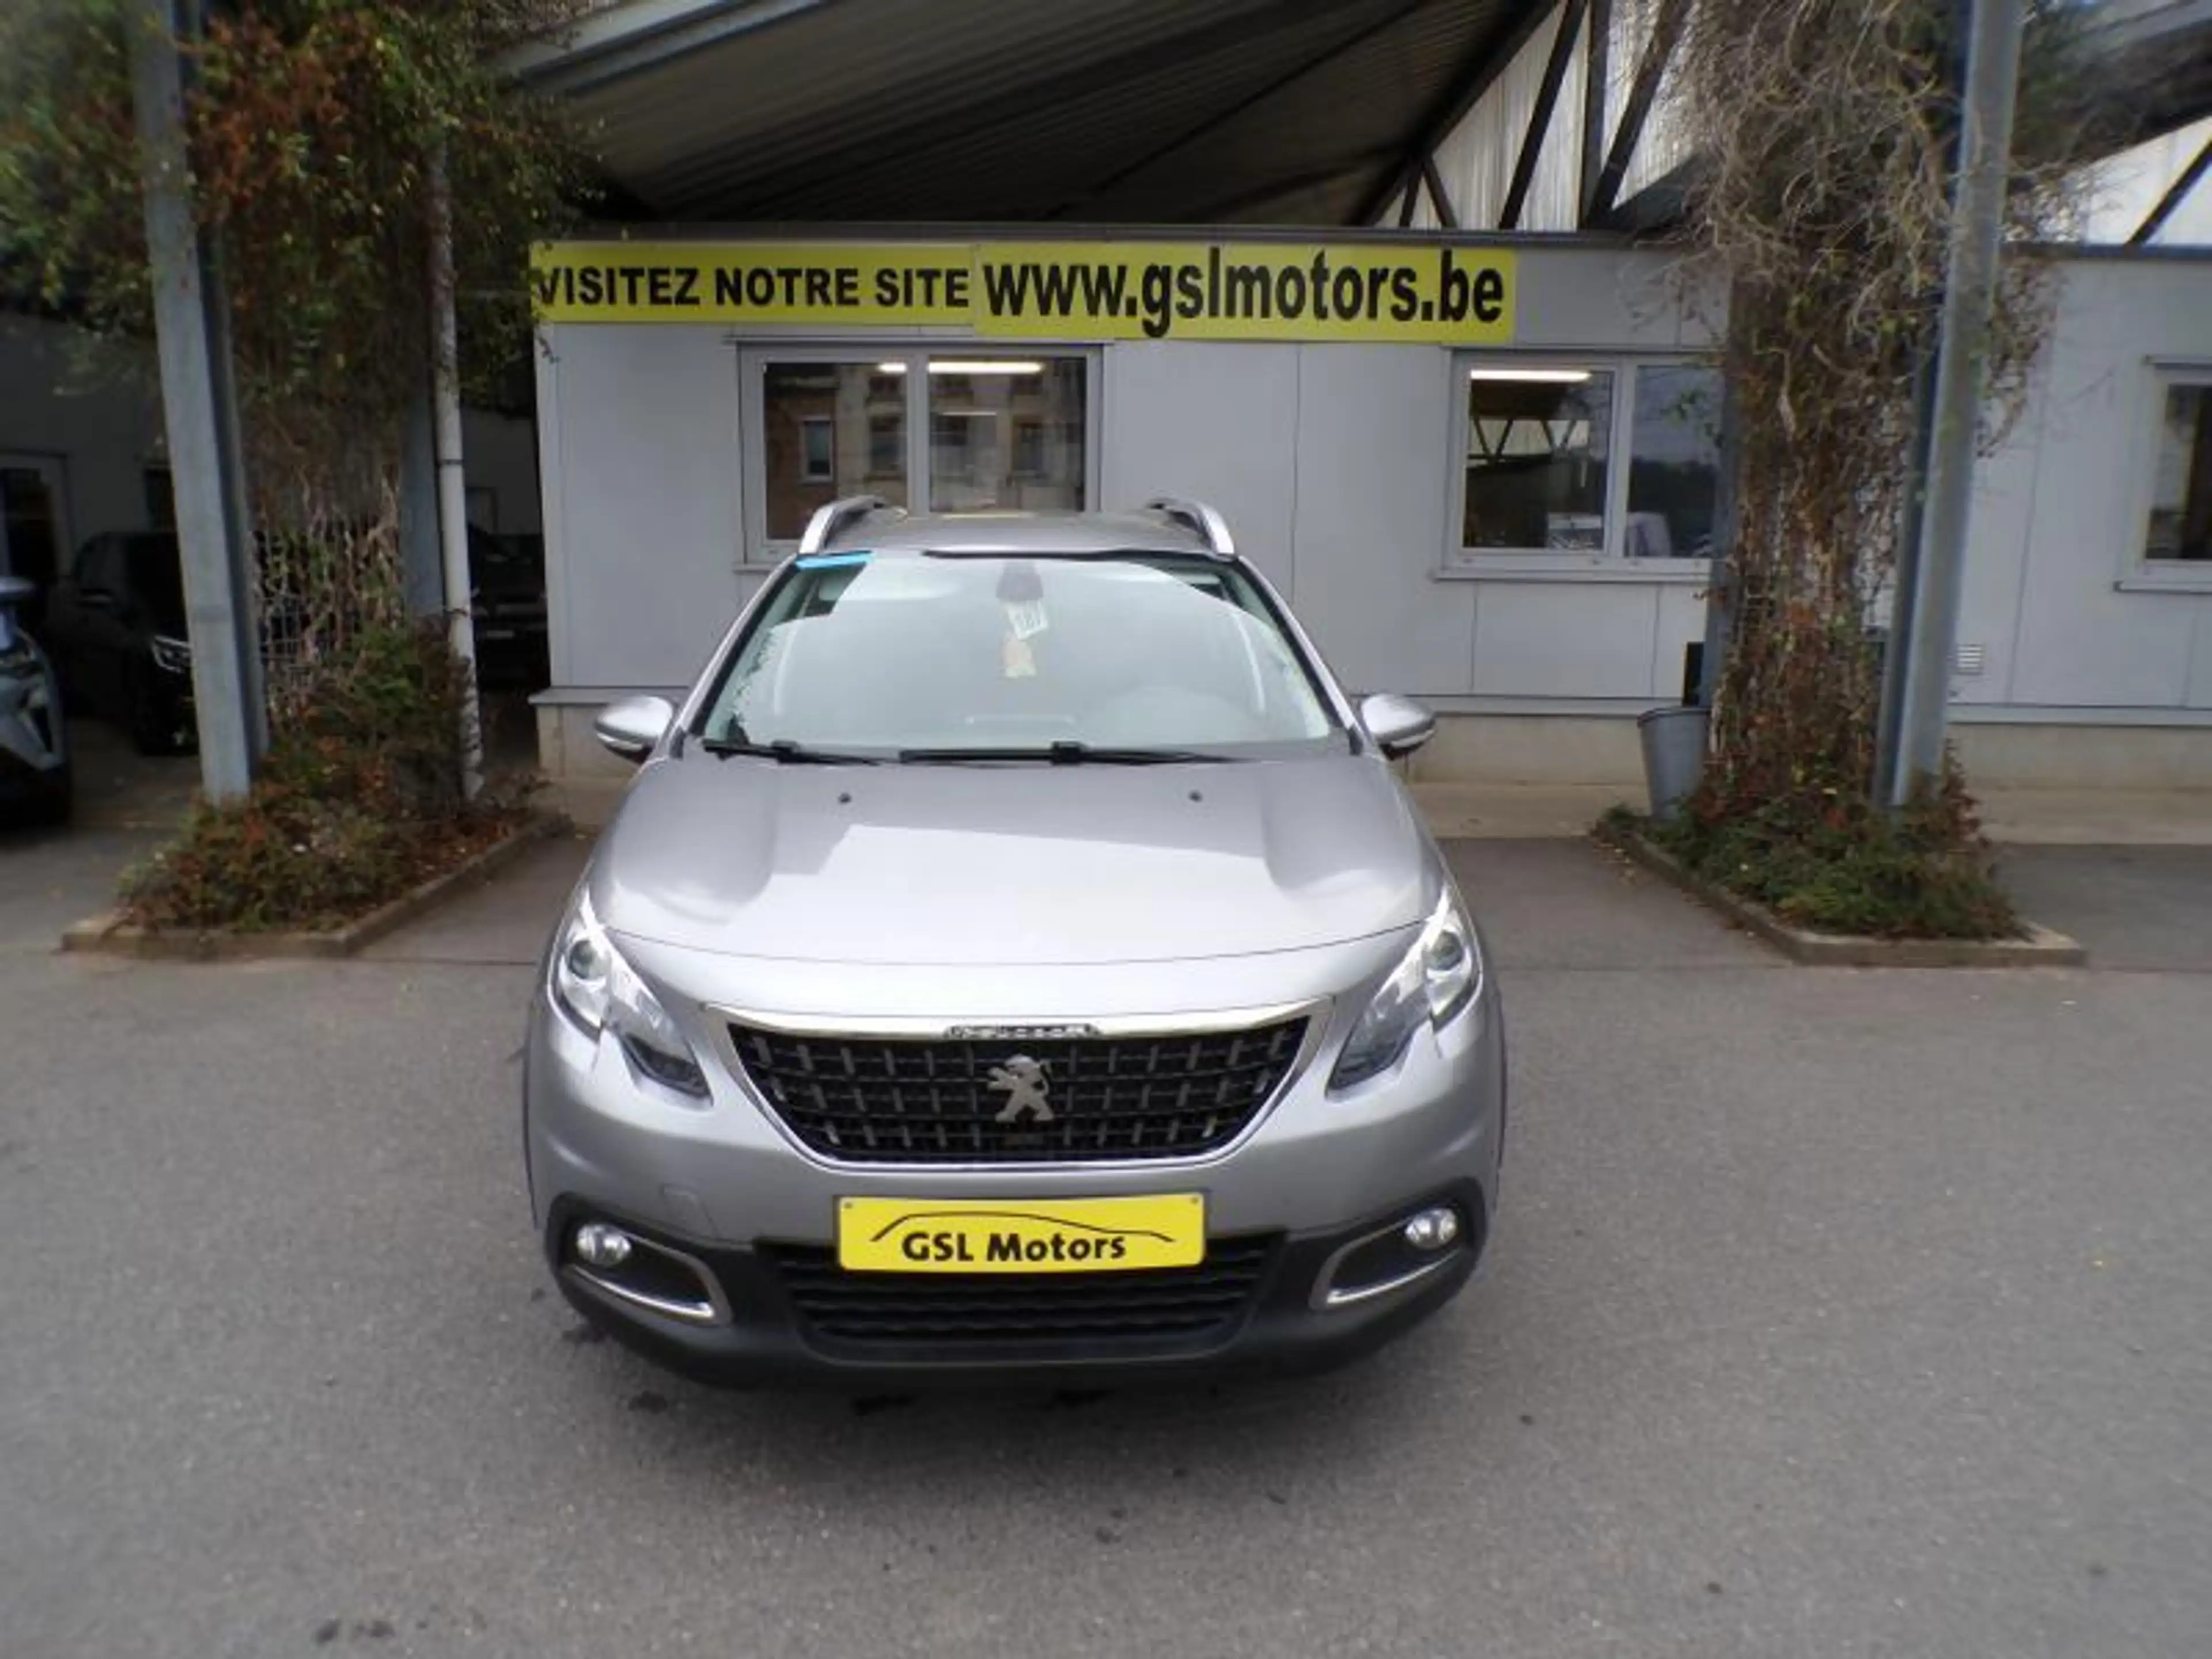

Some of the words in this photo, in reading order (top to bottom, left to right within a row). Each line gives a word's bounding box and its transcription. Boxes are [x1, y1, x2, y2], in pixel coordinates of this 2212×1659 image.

[536, 266, 700, 306] VISITEZ
[715, 267, 858, 308] NOTRE
[876, 268, 969, 308] SITE
[983, 246, 1503, 338] www.gslmotors.be
[902, 1232, 974, 1262] GSL
[986, 1232, 1126, 1262] Motors
